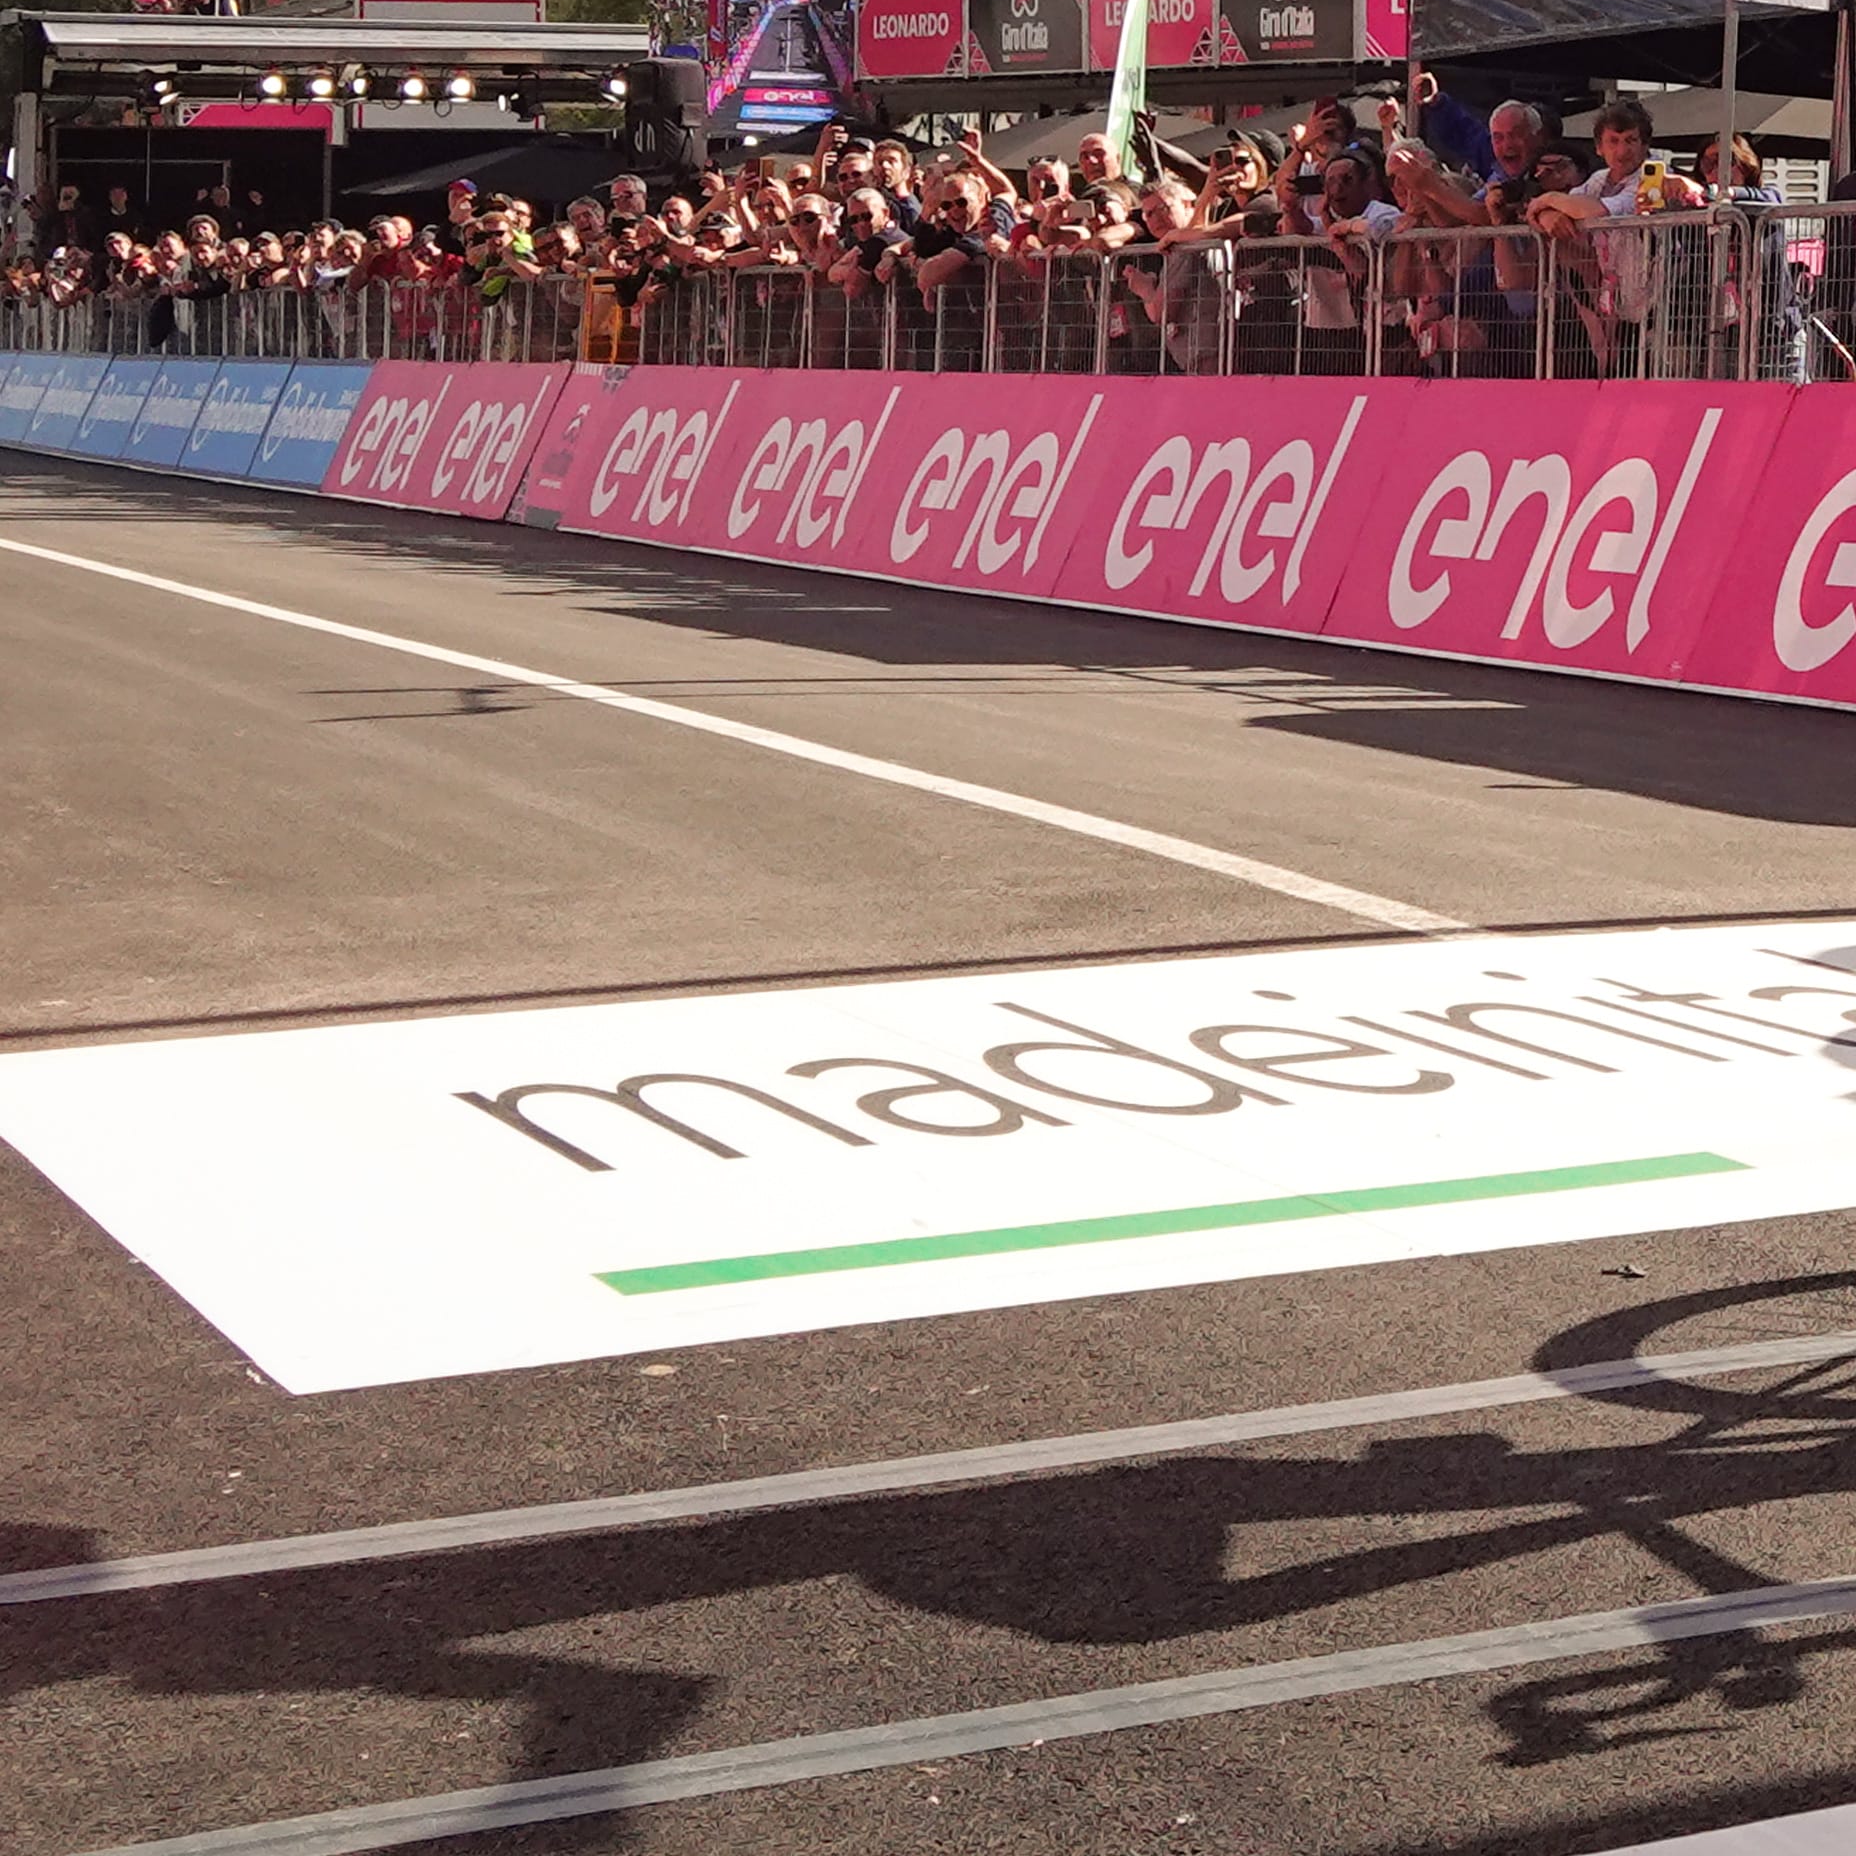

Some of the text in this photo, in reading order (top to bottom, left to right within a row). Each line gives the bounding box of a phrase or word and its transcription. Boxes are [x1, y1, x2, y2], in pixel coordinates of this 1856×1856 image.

[873, 13, 949, 39] LEONARDO
[340, 374, 452, 492] enel
[430, 375, 551, 505] enel
[589, 379, 741, 528] enel
[727, 386, 901, 548] enel
[889, 393, 1103, 576] enel
[1103, 395, 1367, 606] enel
[1388, 408, 1723, 655] enel
